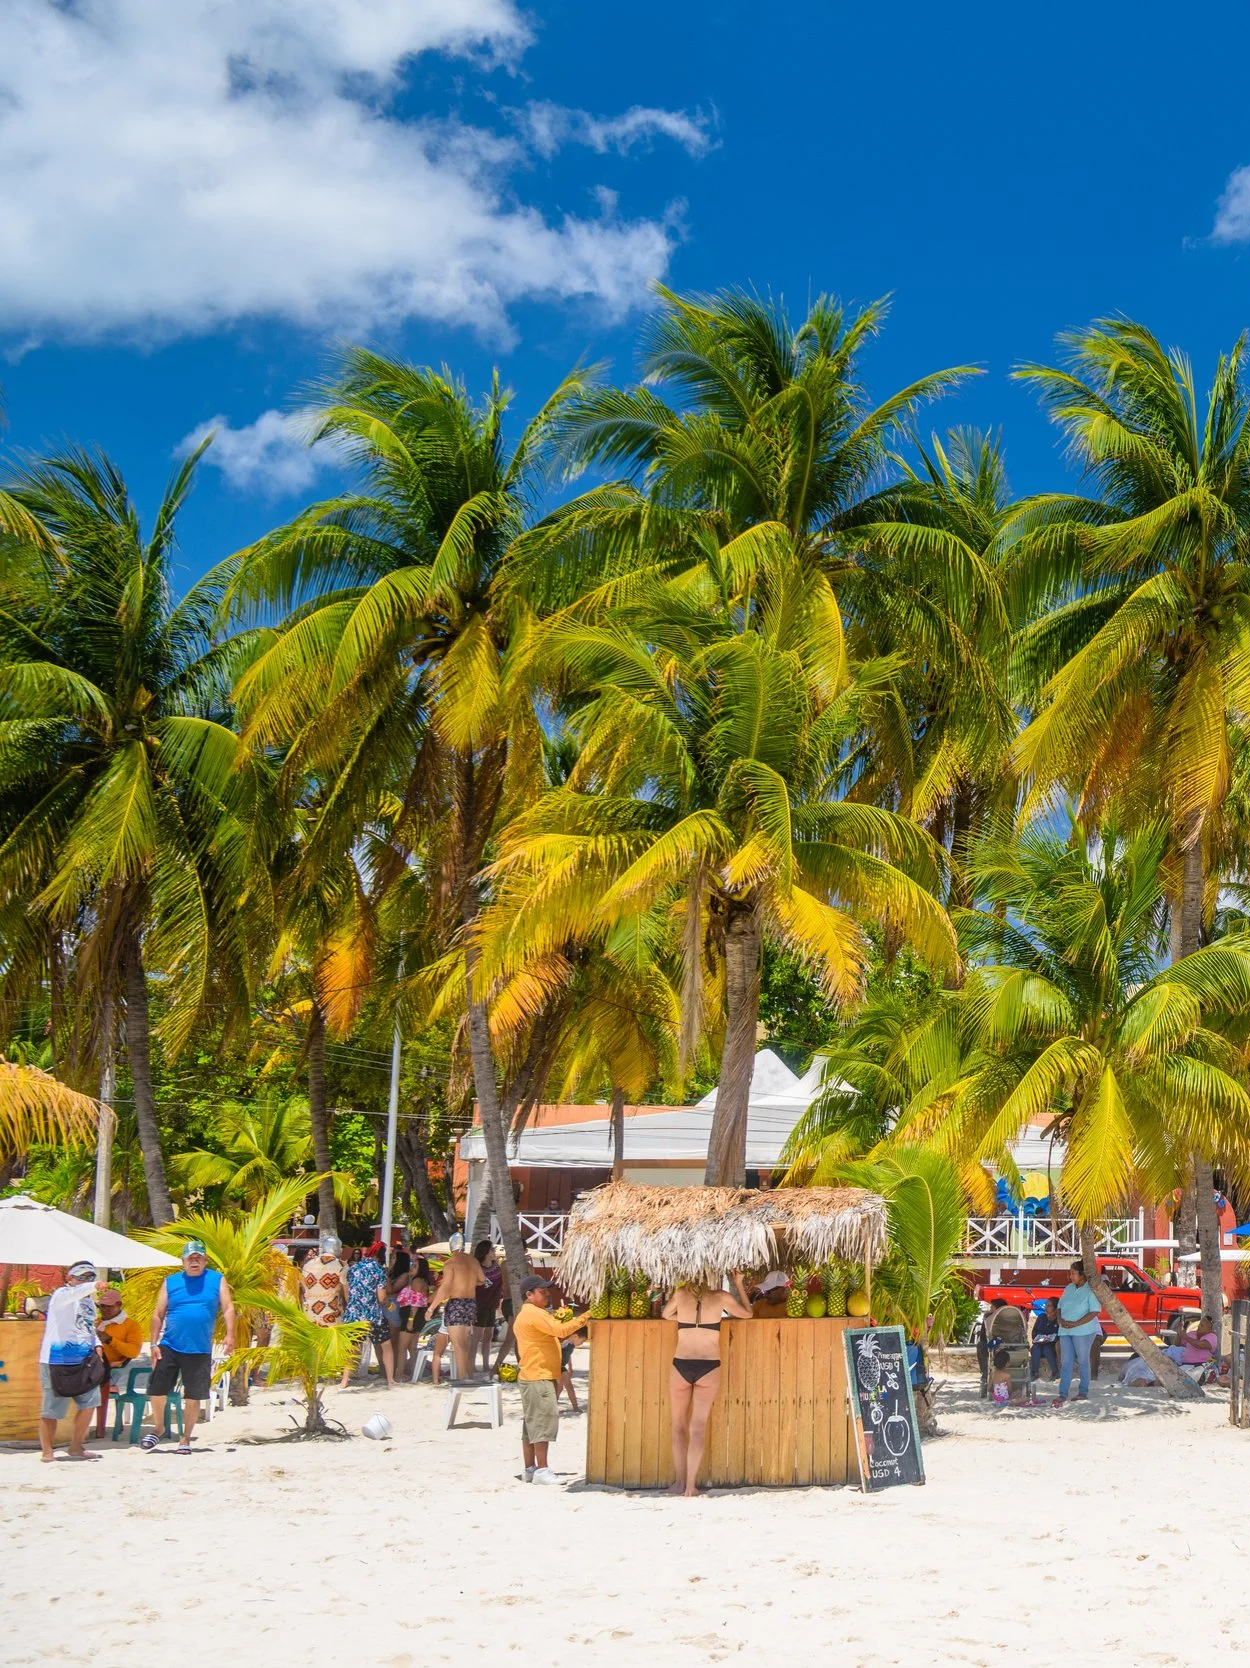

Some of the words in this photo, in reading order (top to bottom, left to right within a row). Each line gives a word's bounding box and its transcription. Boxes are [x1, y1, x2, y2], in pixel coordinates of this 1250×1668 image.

[880, 1362, 893, 1370] USD
[894, 1361, 900, 1372] 9
[870, 1457, 899, 1468] Coconut
[872, 1469, 890, 1478] USD
[894, 1466, 901, 1477] 4
